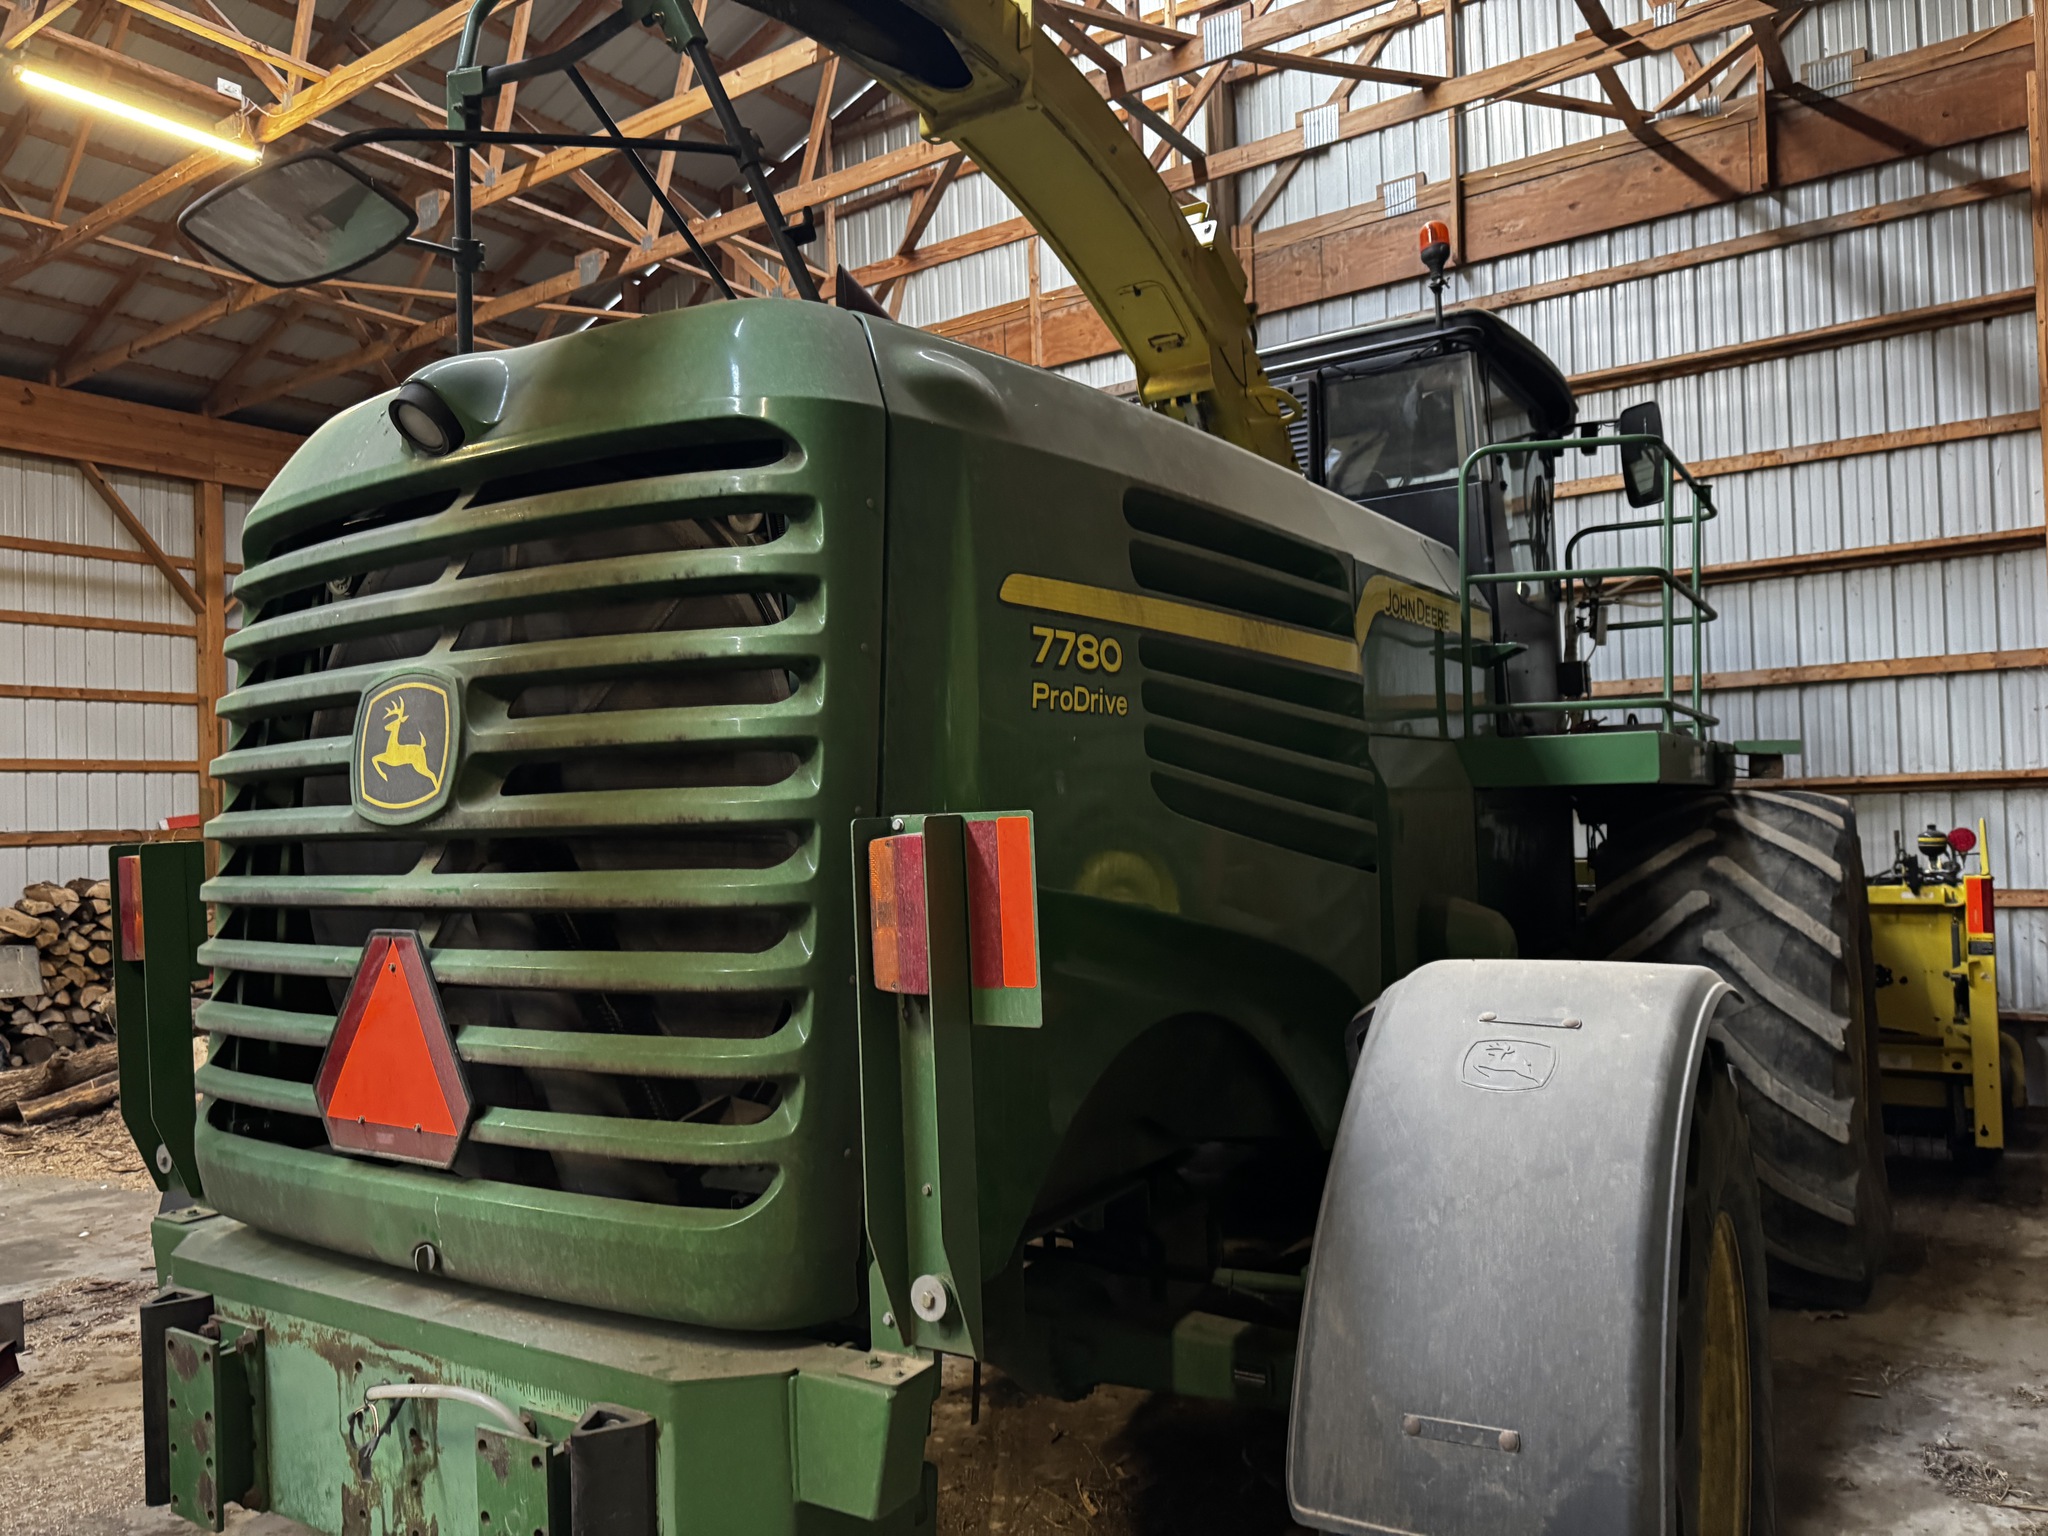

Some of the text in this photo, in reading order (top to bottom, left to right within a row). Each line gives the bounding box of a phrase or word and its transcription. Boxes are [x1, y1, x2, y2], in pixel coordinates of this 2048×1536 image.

[1385, 587, 1451, 630] JOHN DEERE
[1032, 625, 1123, 673] 7780
[1032, 682, 1128, 716] ProDrive
